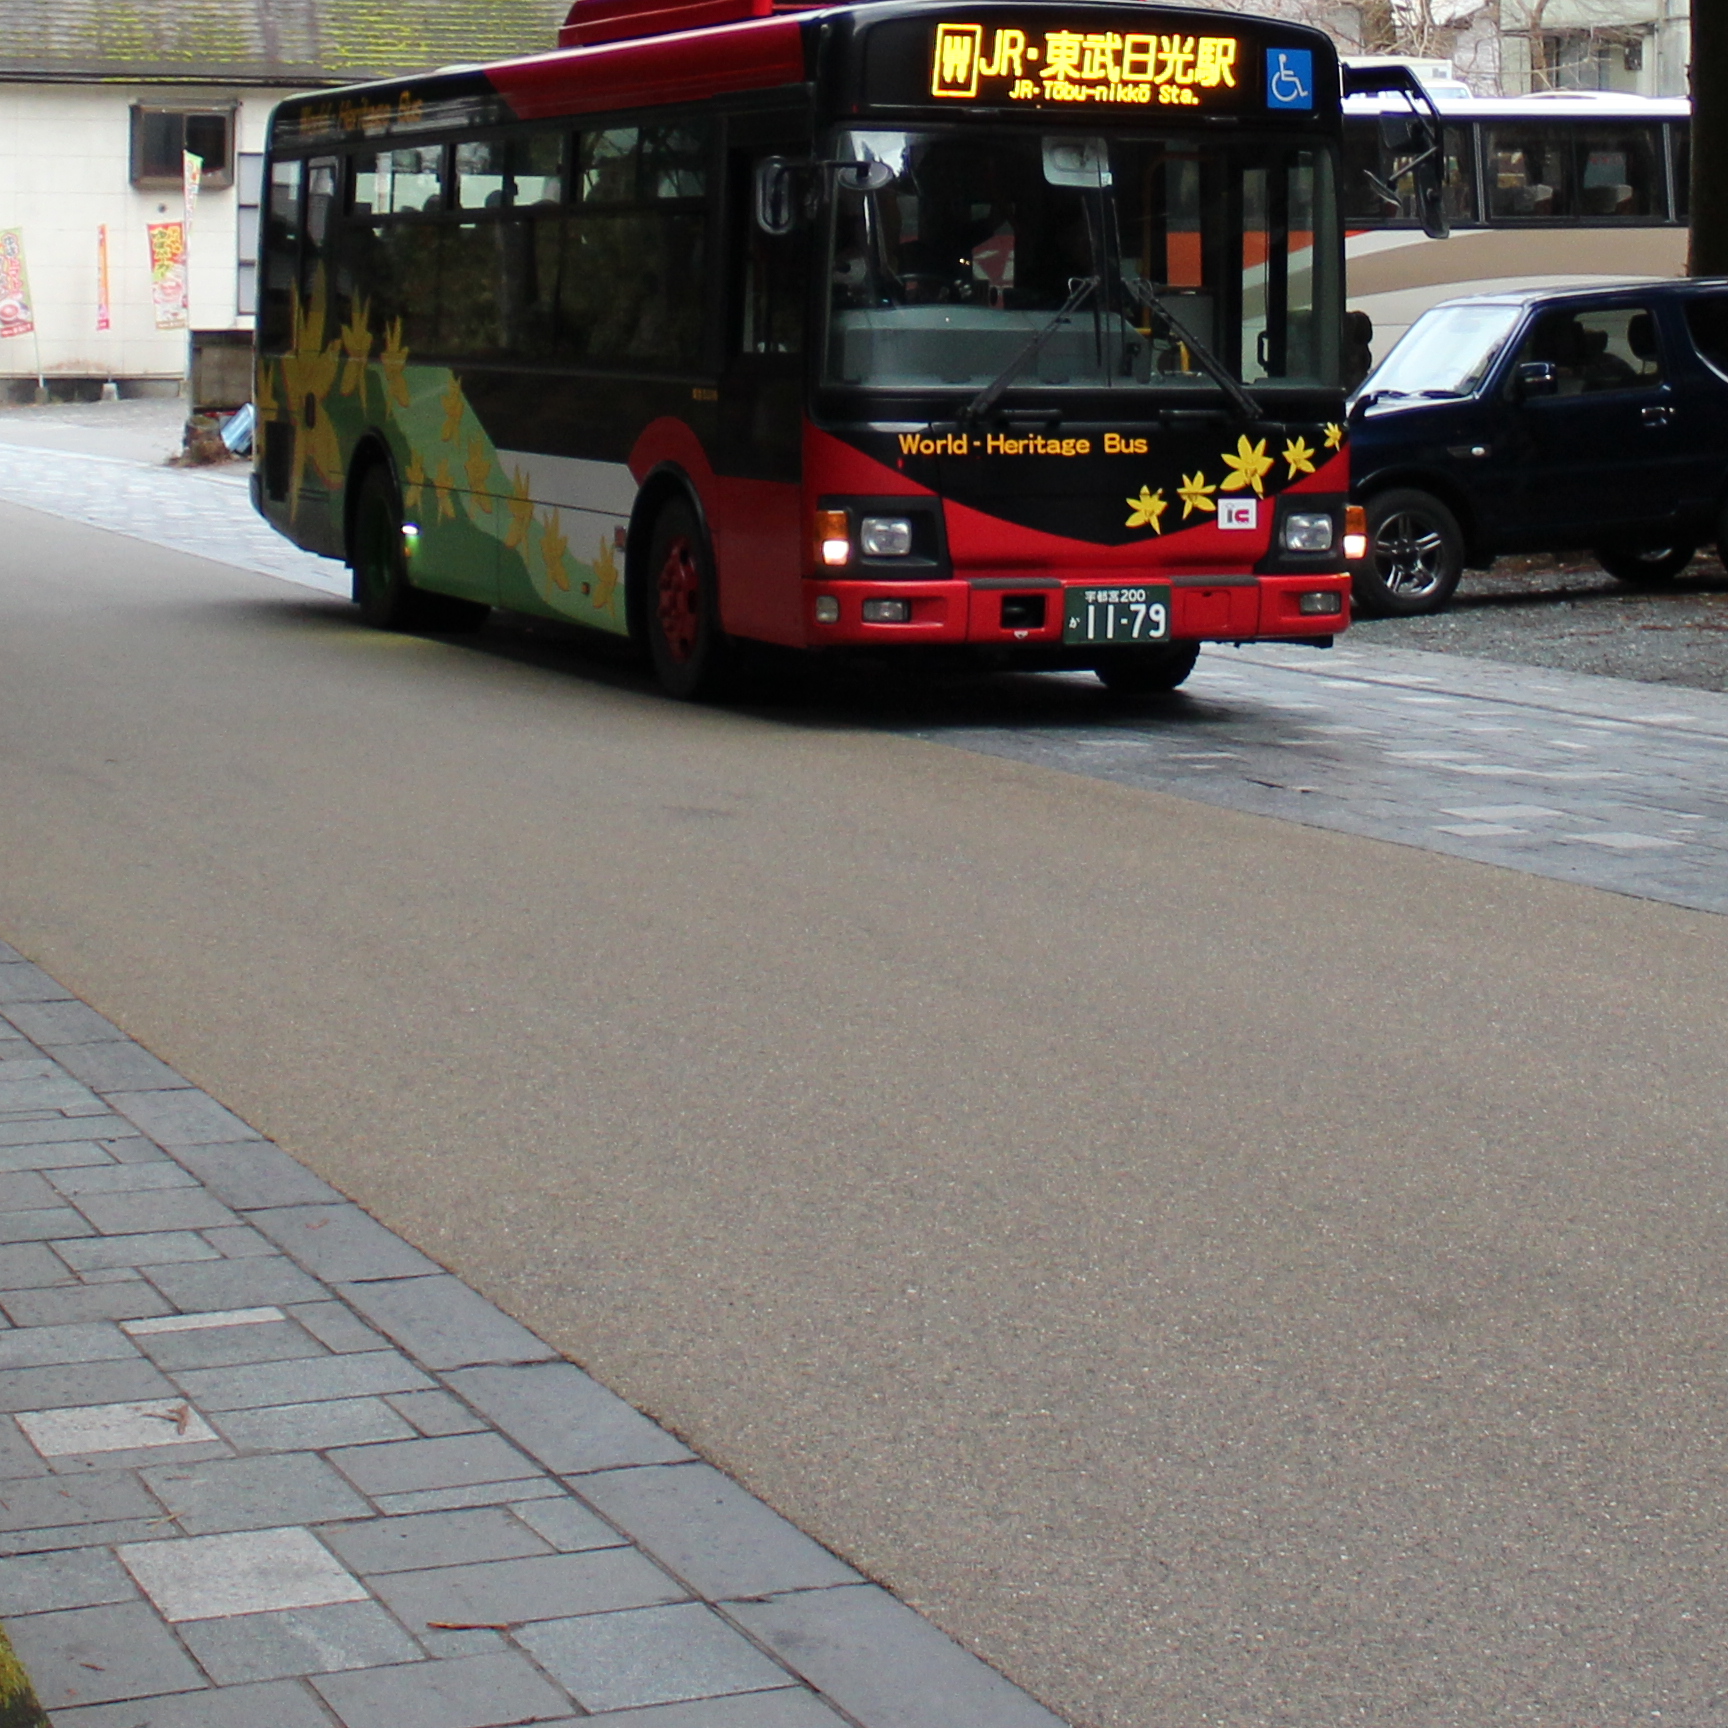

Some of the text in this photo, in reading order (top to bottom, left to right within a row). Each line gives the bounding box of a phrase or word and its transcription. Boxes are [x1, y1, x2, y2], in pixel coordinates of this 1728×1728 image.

[1158, 84, 1200, 105] Sta.
[1103, 433, 1149, 455] Bus
[1087, 603, 1167, 640] 11-79
